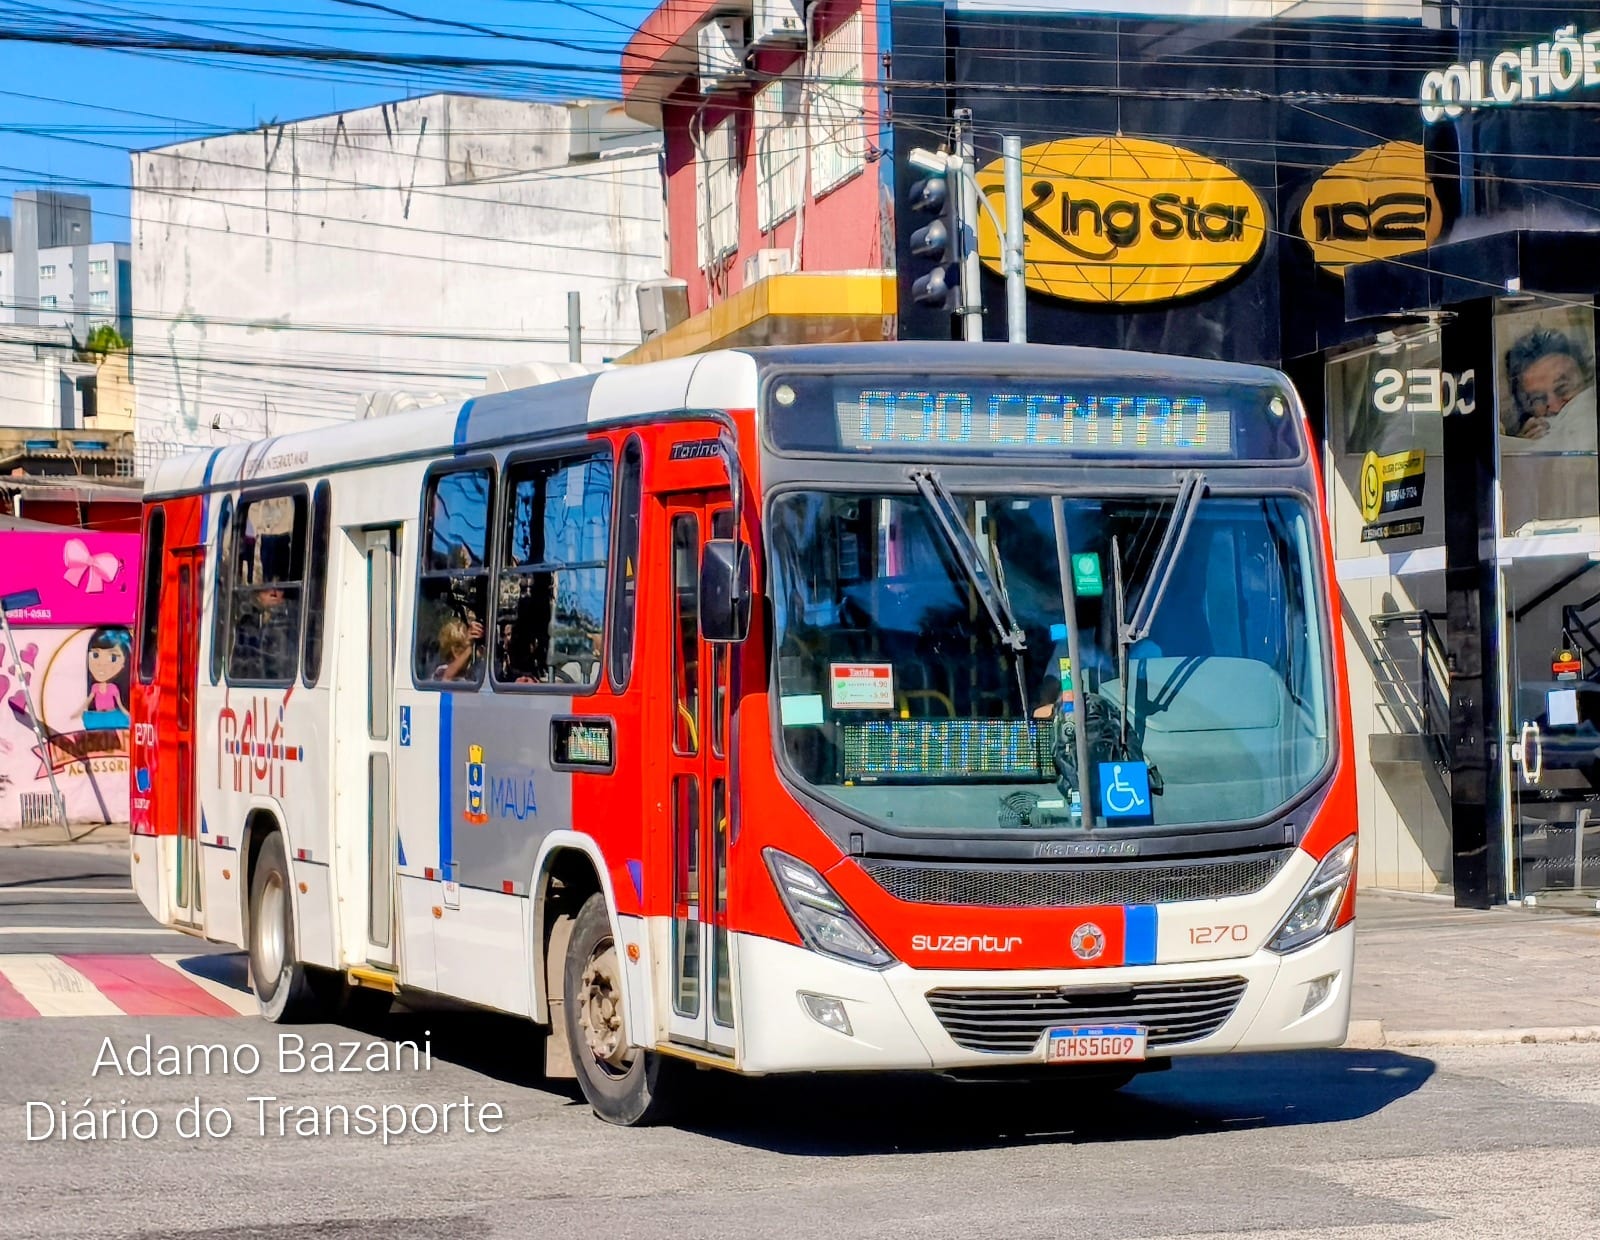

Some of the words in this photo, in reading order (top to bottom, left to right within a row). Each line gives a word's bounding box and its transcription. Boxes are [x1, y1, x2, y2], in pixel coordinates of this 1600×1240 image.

[1150, 193, 1249, 242] Star
[859, 391, 970, 441] 030
[988, 393, 1207, 445] CENTRO
[672, 441, 719, 459] Torino
[490, 769, 538, 820] MAUÁ
[911, 934, 1022, 952] suzantur
[1189, 924, 1249, 945] 1270
[1056, 1037, 1134, 1058] GHS5G09
